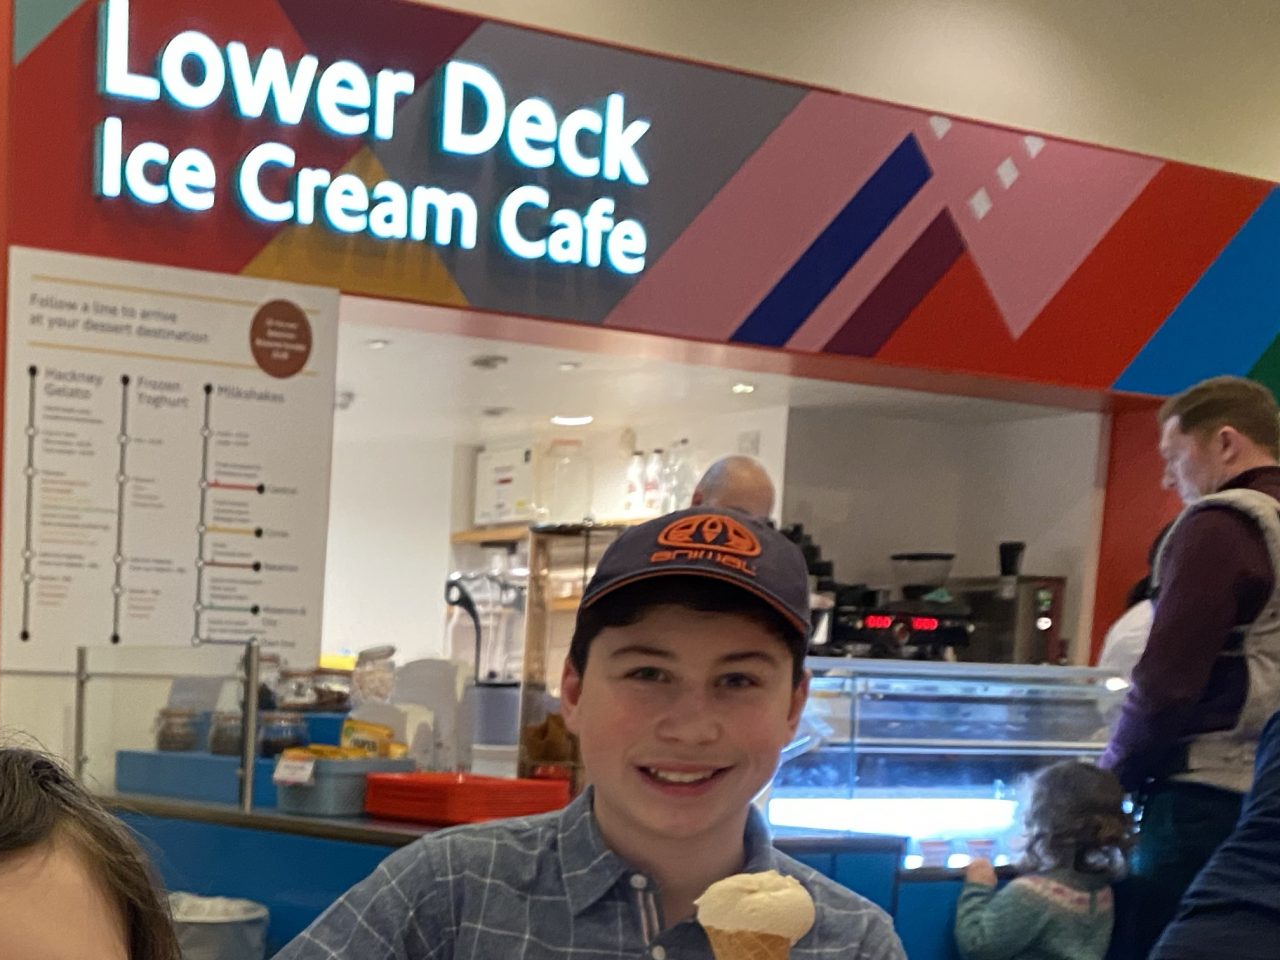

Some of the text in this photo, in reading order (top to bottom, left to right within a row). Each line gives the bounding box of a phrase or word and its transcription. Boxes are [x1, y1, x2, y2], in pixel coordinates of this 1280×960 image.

[101, 0, 651, 186] Lower Deck
[98, 116, 647, 275] Ice Cream Cafe
[30, 293, 177, 323] Follow a line to arrive
[30, 313, 209, 344] at your dessert destination
[45, 368, 104, 388] Hackney
[136, 376, 181, 392] Frozen
[45, 382, 92, 400] Gelato
[217, 386, 285, 403] Milkshakes
